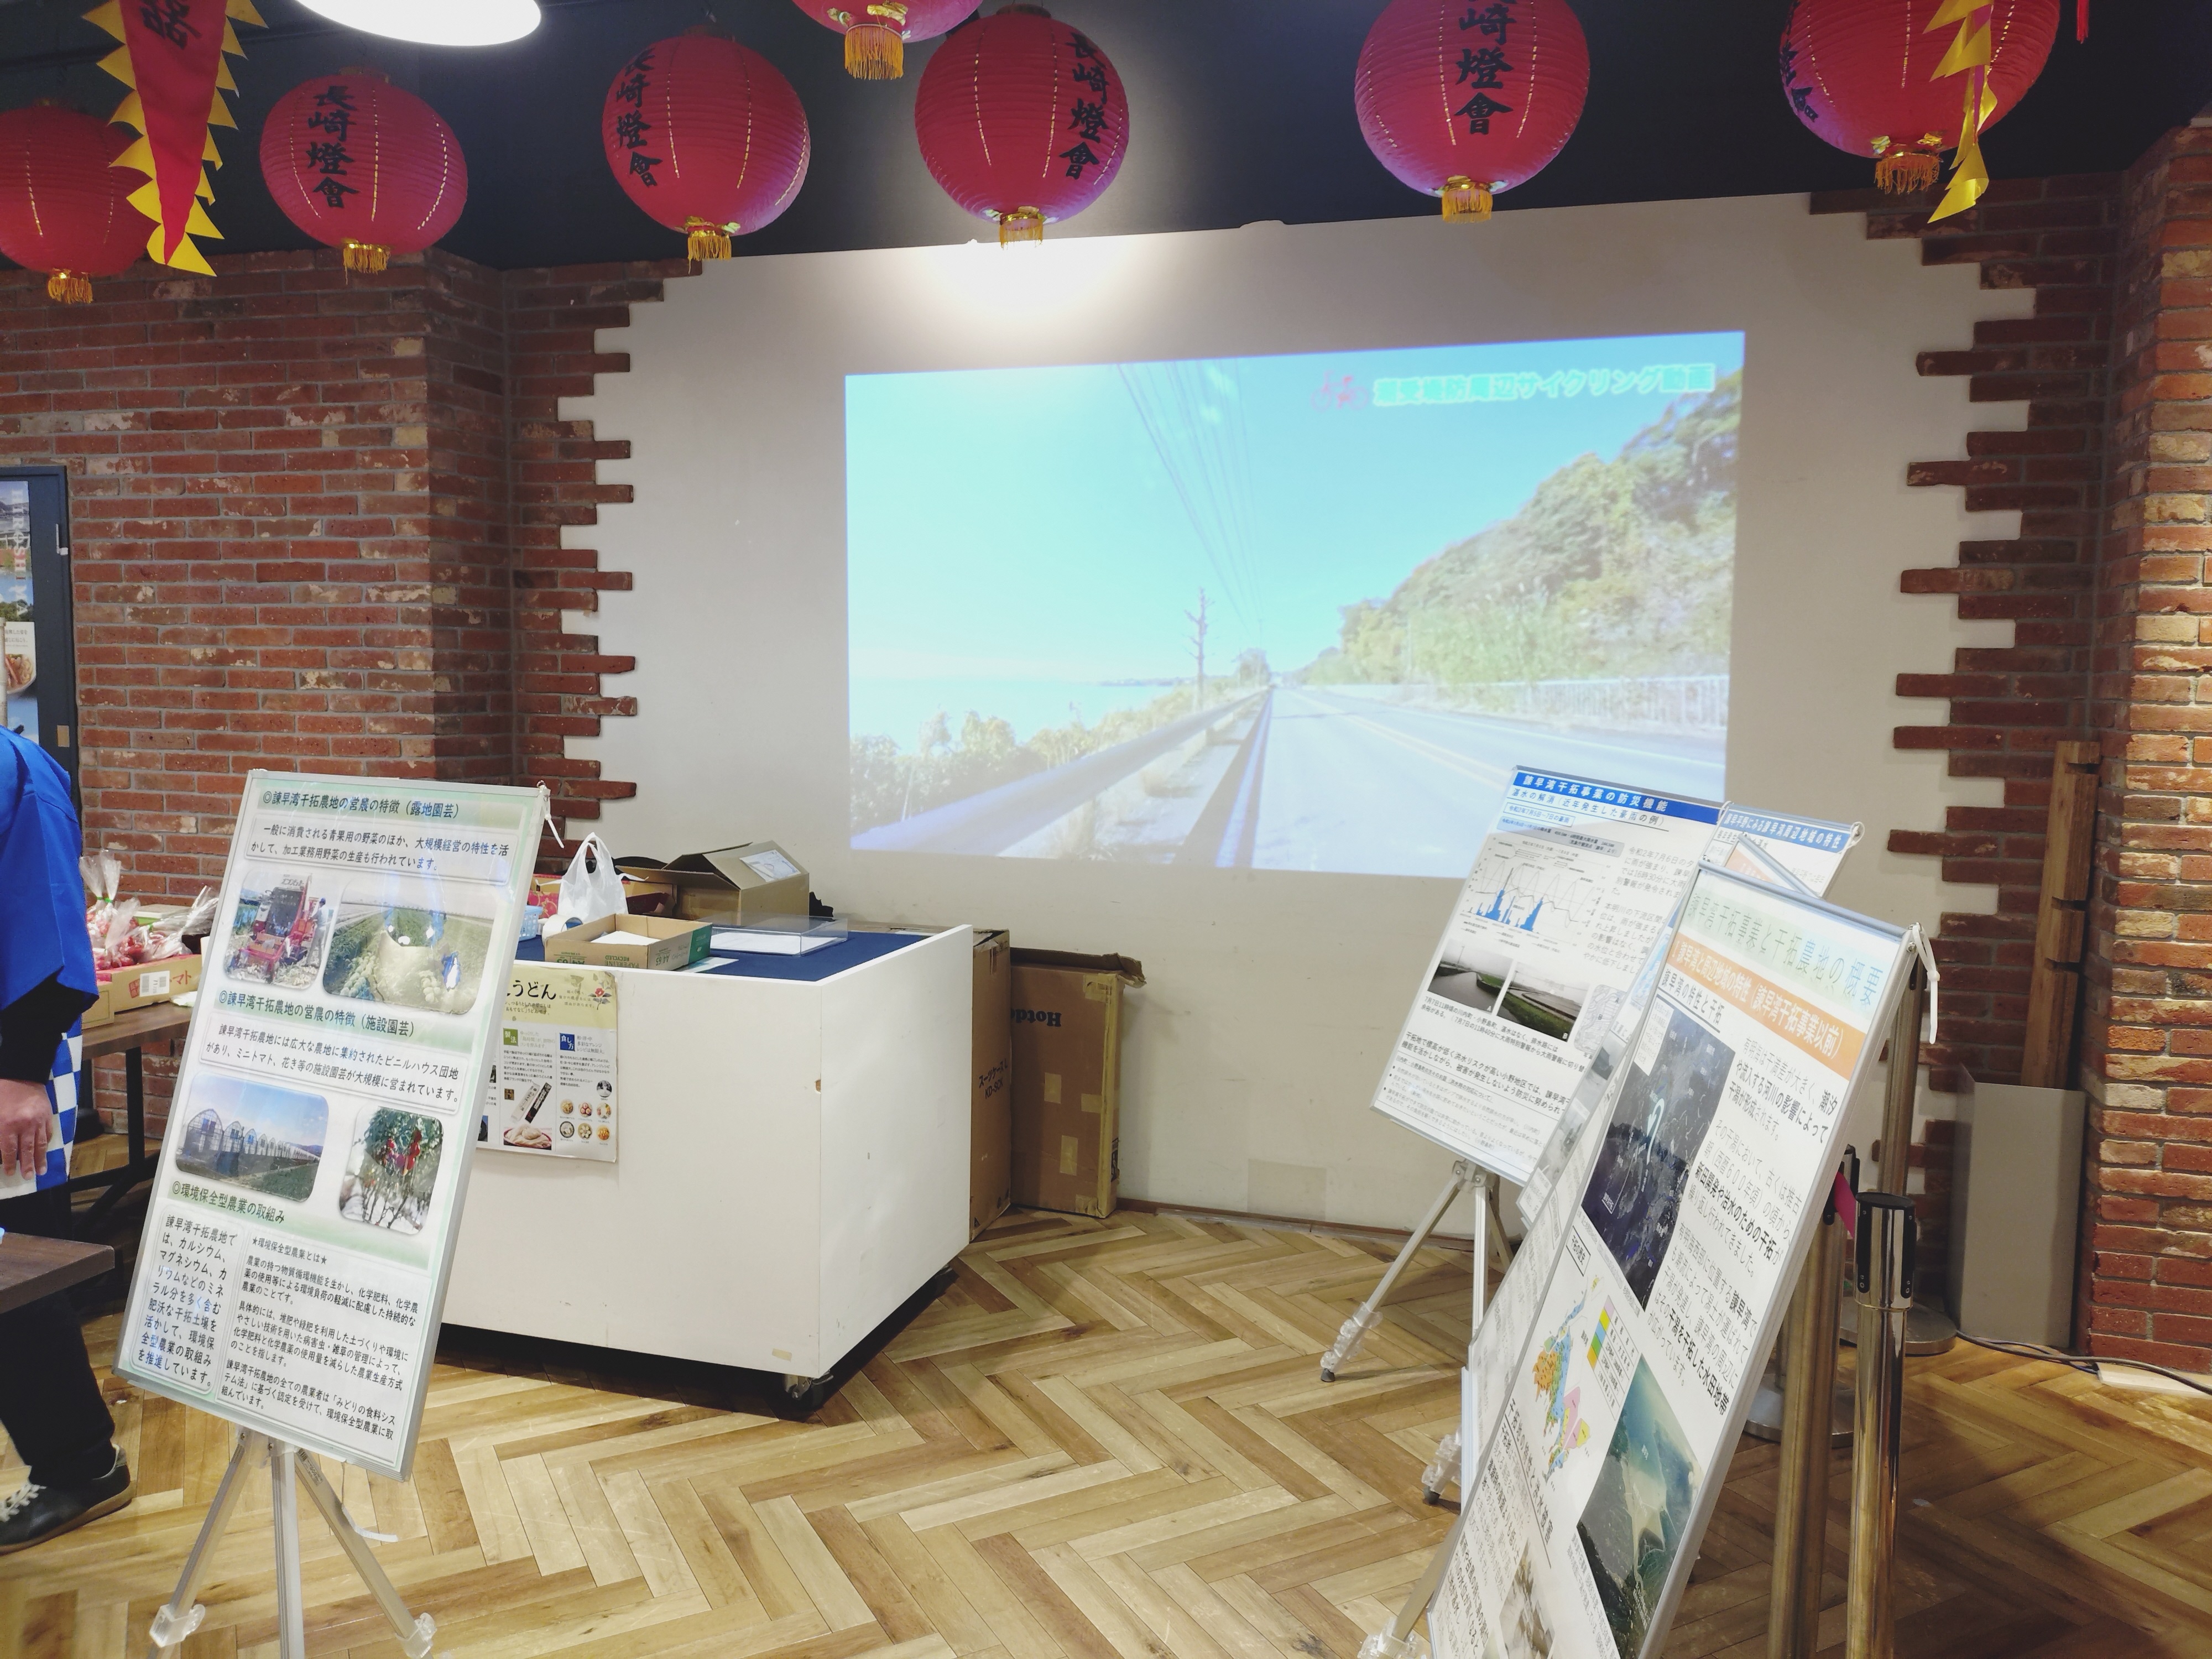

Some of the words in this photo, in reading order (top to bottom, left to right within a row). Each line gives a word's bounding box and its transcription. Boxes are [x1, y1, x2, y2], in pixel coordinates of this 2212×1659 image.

[1453, 0, 1517, 134] 崎燈會
[1058, 32, 1109, 180] 長崎燈會
[306, 85, 359, 209] 長崎燈會
[251, 842, 439, 870] かして、加工業務用野菜の生産も行われています。
[263, 825, 509, 857] 一般に消費される青果用の野菜のほか、大規模経営の特性を活
[170, 970, 192, 985] マト
[218, 1023, 459, 1079] 諫早湾干拓農地には広大な農地に集約されたビニルハウス団地
[206, 1042, 458, 1103] があり、ミニトマト、花き等の施設園芸が大規模に営まれています。
[1726, 1080, 1783, 1141] 干潟が形成されます。
[1734, 1059, 1828, 1144] や流入する河川の影響によって
[165, 1214, 238, 1246] 諫早湾干拓農地で
[1693, 1161, 1785, 1266] 新田開発や治水のための干拓が
[162, 1232, 226, 1263] は、カルシウム、
[158, 1265, 224, 1298] リウムなどのミネ
[160, 1250, 227, 1281] マグネシウム、カ
[153, 1282, 221, 1314] ラル分を多く含む
[242, 1281, 293, 1305] 農業のことです。
[148, 1298, 216, 1332] 肥沃な干拓土壌を
[141, 1332, 211, 1366] 全型農業の取組み
[144, 1315, 215, 1350] 活かして、環境保
[138, 1349, 211, 1387] を推進しています。
[231, 1340, 287, 1367] のことを指します。
[221, 1385, 264, 1410] 組んでいます。
